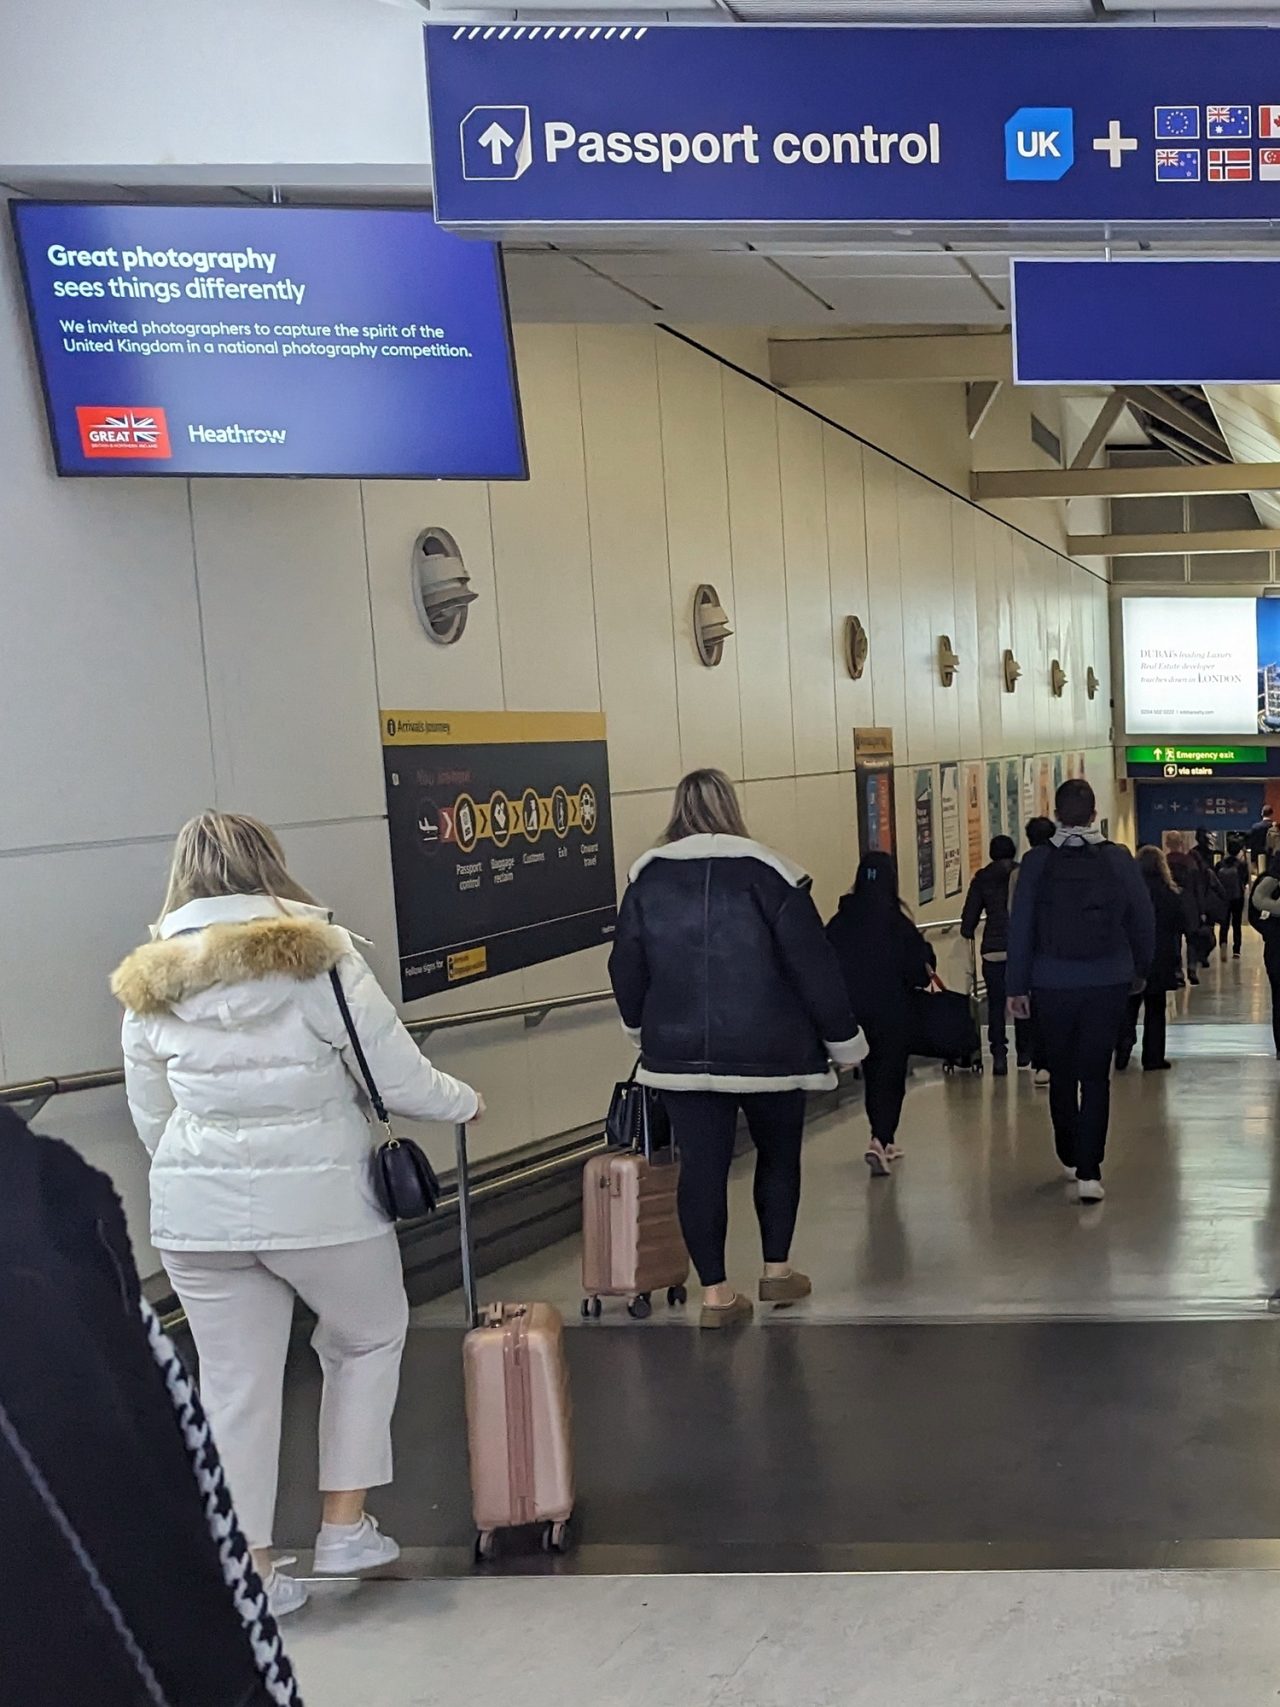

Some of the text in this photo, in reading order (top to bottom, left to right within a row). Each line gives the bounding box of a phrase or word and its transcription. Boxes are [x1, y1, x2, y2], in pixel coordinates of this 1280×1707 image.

[545, 121, 941, 172] Passport control
[1016, 131, 1061, 157] UK
[47, 244, 277, 274] Great photography
[53, 278, 305, 305] sees things differently
[60, 319, 445, 342] We invited photographers to capture the spirit of the
[63, 338, 473, 361] United Kingdom in a national photography competition.
[89, 430, 130, 442] GREAT
[188, 425, 287, 444] Heathrow
[1198, 672, 1242, 684] LONDON
[1176, 751, 1234, 760] Emergency exit
[1178, 767, 1213, 775] via stairs
[456, 862, 482, 875] Passport
[460, 876, 480, 890] control
